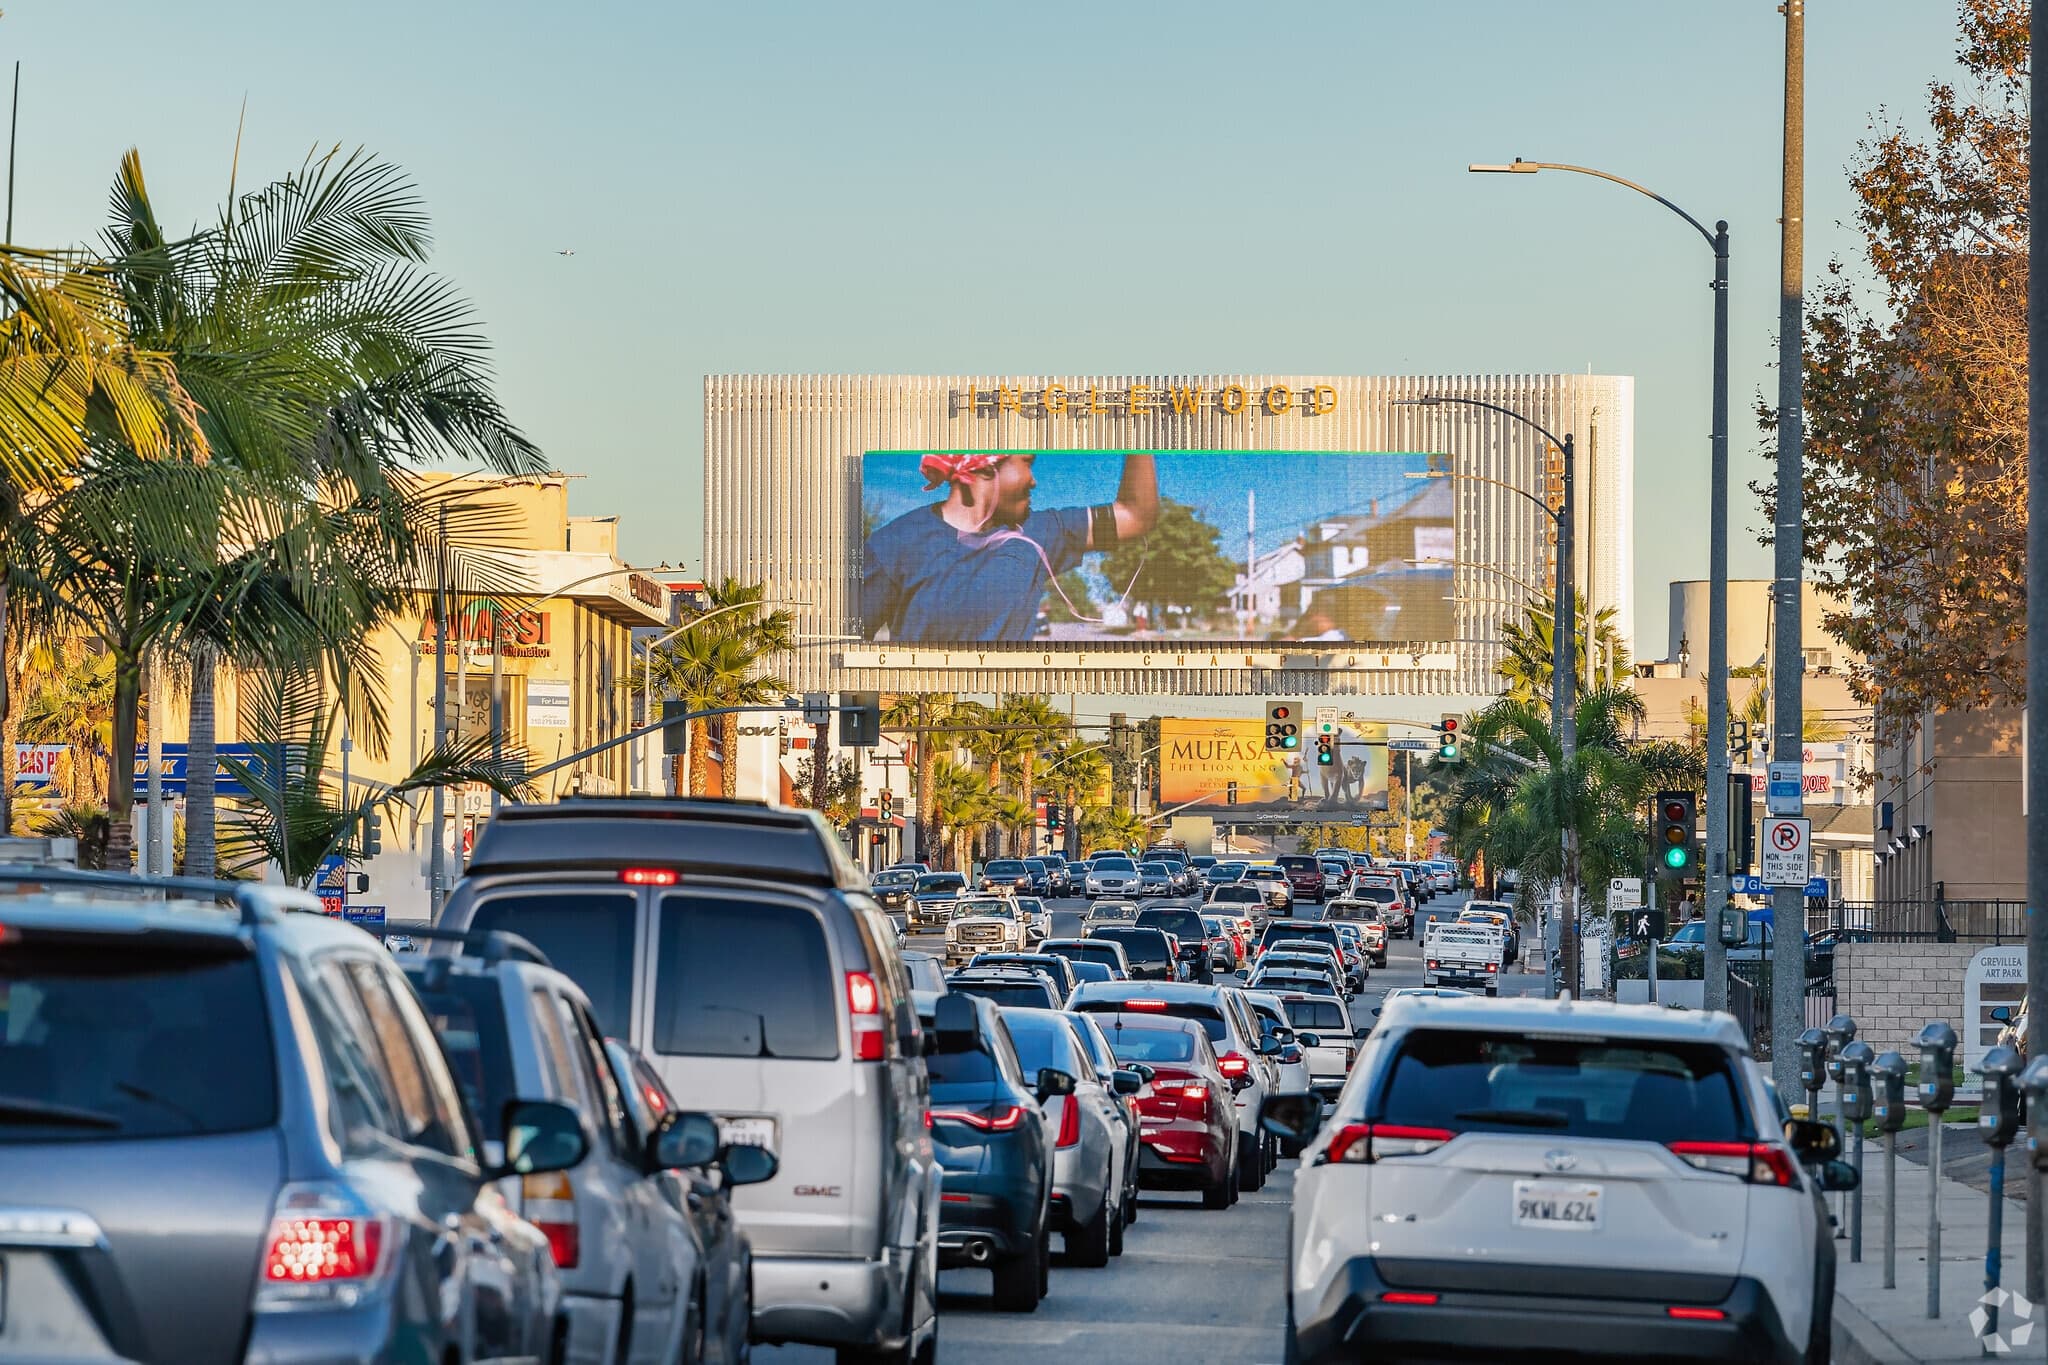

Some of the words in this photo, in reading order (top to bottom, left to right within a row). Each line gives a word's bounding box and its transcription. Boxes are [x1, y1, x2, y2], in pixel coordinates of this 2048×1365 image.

[969, 384, 1338, 414] INGLEWOOD
[878, 653, 986, 666] CITY
[1043, 653, 1087, 666] OF
[1143, 654, 1422, 667] CHAMPIONS
[1171, 740, 1275, 760] MUFASA
[20, 750, 44, 774] GAS
[1170, 763, 1192, 771] THE
[1203, 763, 1234, 771] LION
[1243, 763, 1276, 772] KING
[1980, 957, 2022, 966] GREVILLEA
[1985, 969, 2000, 977] ART
[2002, 969, 2022, 977] PARK
[794, 1185, 842, 1197] GMC
